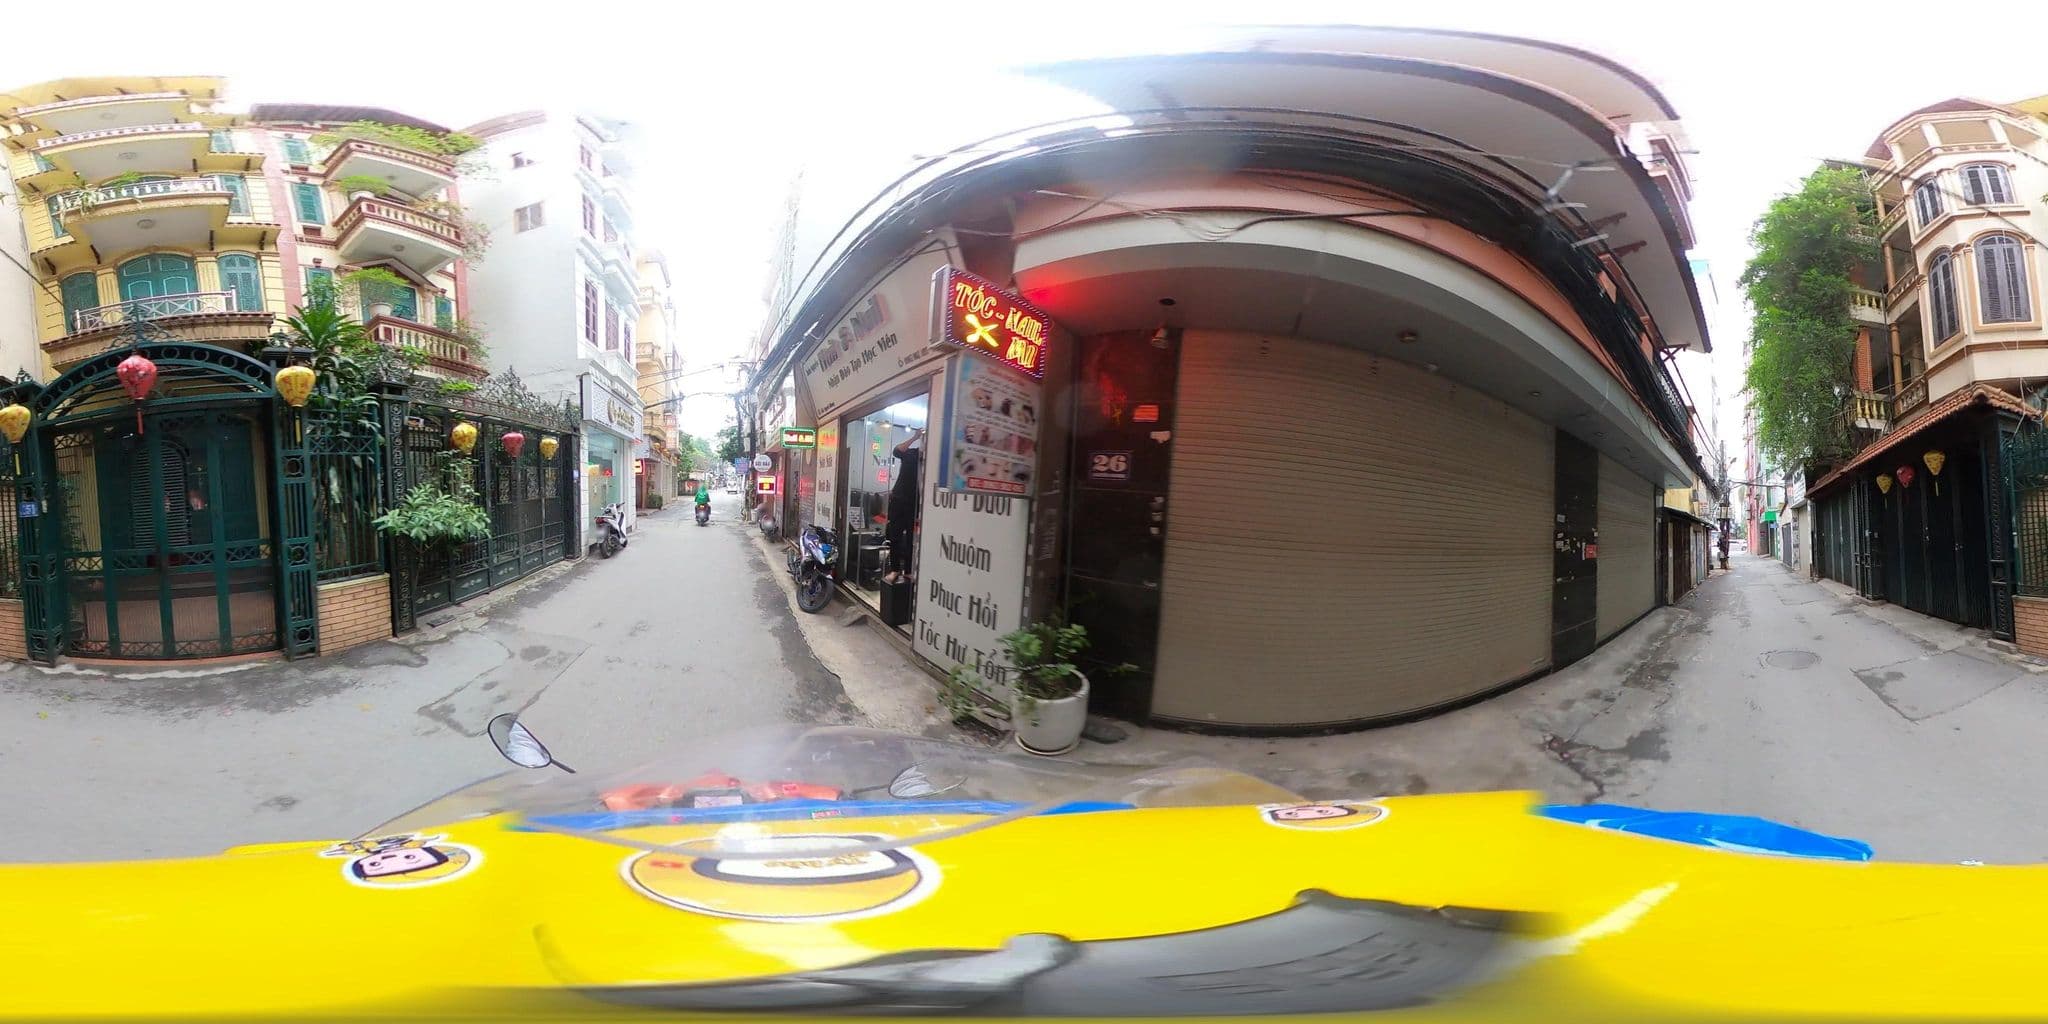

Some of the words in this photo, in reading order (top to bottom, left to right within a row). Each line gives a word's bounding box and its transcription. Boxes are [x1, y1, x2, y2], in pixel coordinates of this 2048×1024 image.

[861, 346, 878, 367] Học
[877, 332, 898, 353] Viên
[1092, 454, 1128, 473] 26
[939, 533, 992, 576] Nhuộm
[929, 578, 963, 618] Phục
[919, 618, 941, 651] Tóc
[945, 634, 968, 665] Hư
[973, 648, 1008, 686] Tổn
